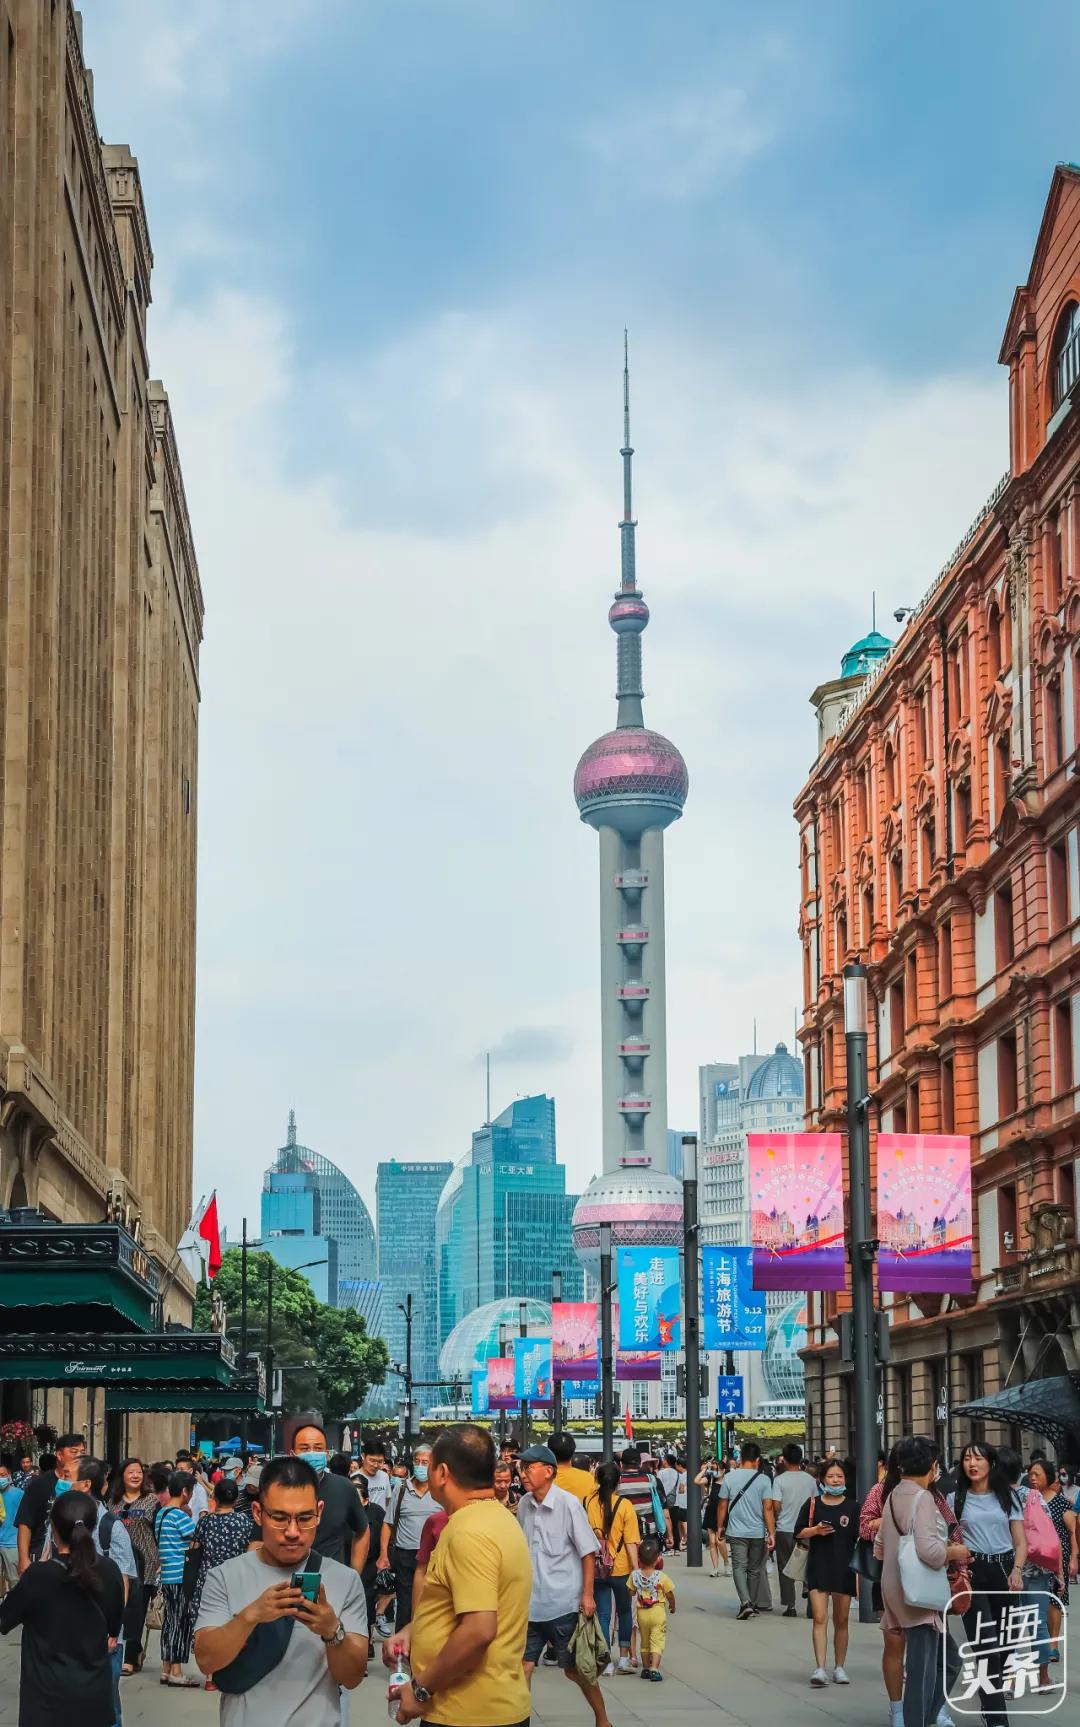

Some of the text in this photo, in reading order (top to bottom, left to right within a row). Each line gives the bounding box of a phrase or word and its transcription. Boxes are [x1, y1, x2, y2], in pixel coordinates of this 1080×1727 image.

[649, 1257, 665, 1285] 走进
[716, 1257, 732, 1334] 上海旅游节
[633, 1272, 649, 1343] 美好与欢乐
[744, 1306, 762, 1315] 9.12
[744, 1326, 762, 1334] 9.27
[64, 1361, 107, 1374] Fairmont
